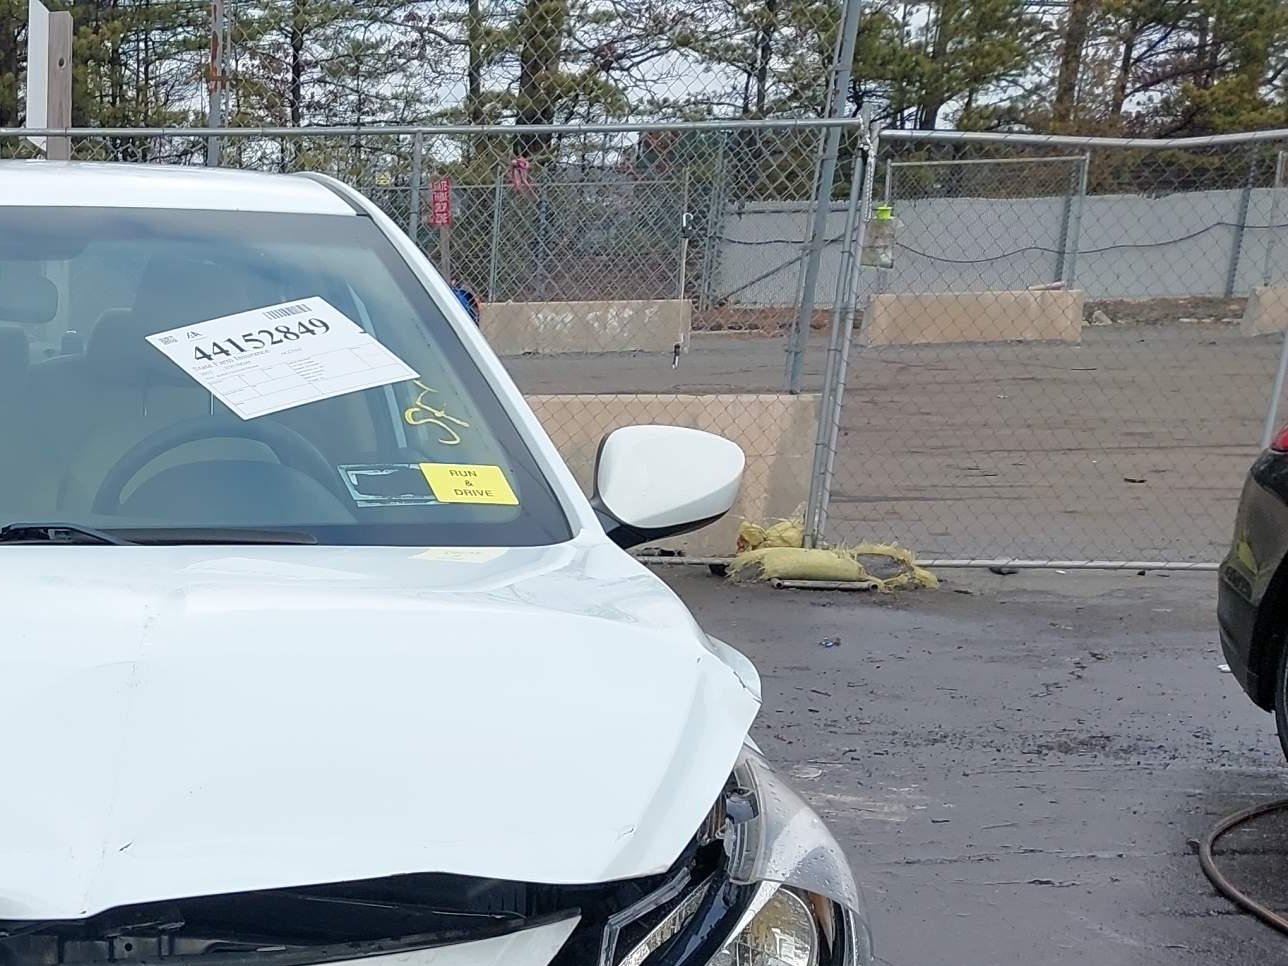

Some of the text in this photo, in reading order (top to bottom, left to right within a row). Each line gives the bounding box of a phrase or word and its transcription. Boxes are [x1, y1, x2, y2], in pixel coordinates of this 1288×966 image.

[194, 317, 330, 361] 44152849
[449, 469, 478, 478] RUN
[464, 479, 475, 487] &
[454, 488, 494, 497] DRIVE
